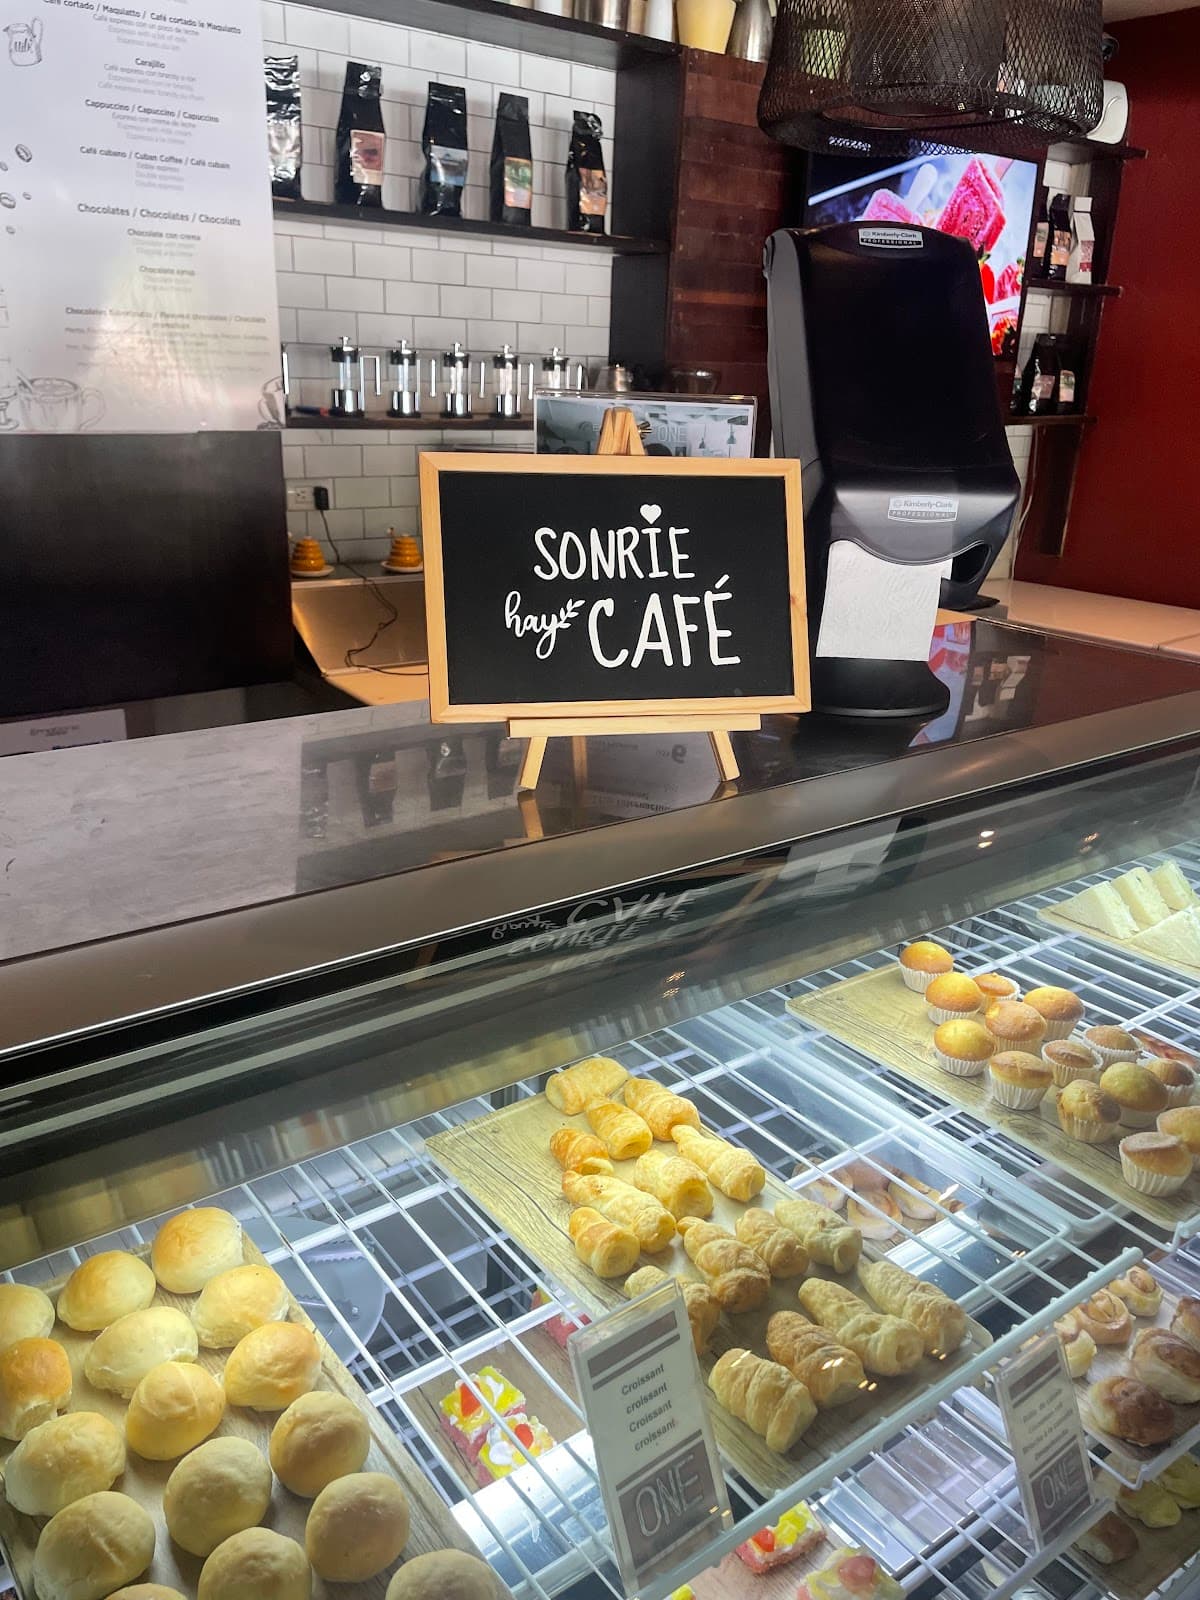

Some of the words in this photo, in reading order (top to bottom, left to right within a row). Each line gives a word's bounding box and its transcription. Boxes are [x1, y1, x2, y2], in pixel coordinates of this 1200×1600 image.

[77, 203, 130, 217] Chocolates
[140, 208, 189, 222] Chocolates
[659, 424, 688, 443] ONE
[504, 590, 558, 660] hay
[588, 574, 741, 669] CAFÉ
[621, 1363, 665, 1396] Croissant
[626, 1382, 668, 1415] croissant
[629, 1400, 672, 1433] Croissant
[634, 1418, 677, 1451] croissant
[635, 1454, 704, 1537] ONE
[1040, 1458, 1082, 1509] ONE
